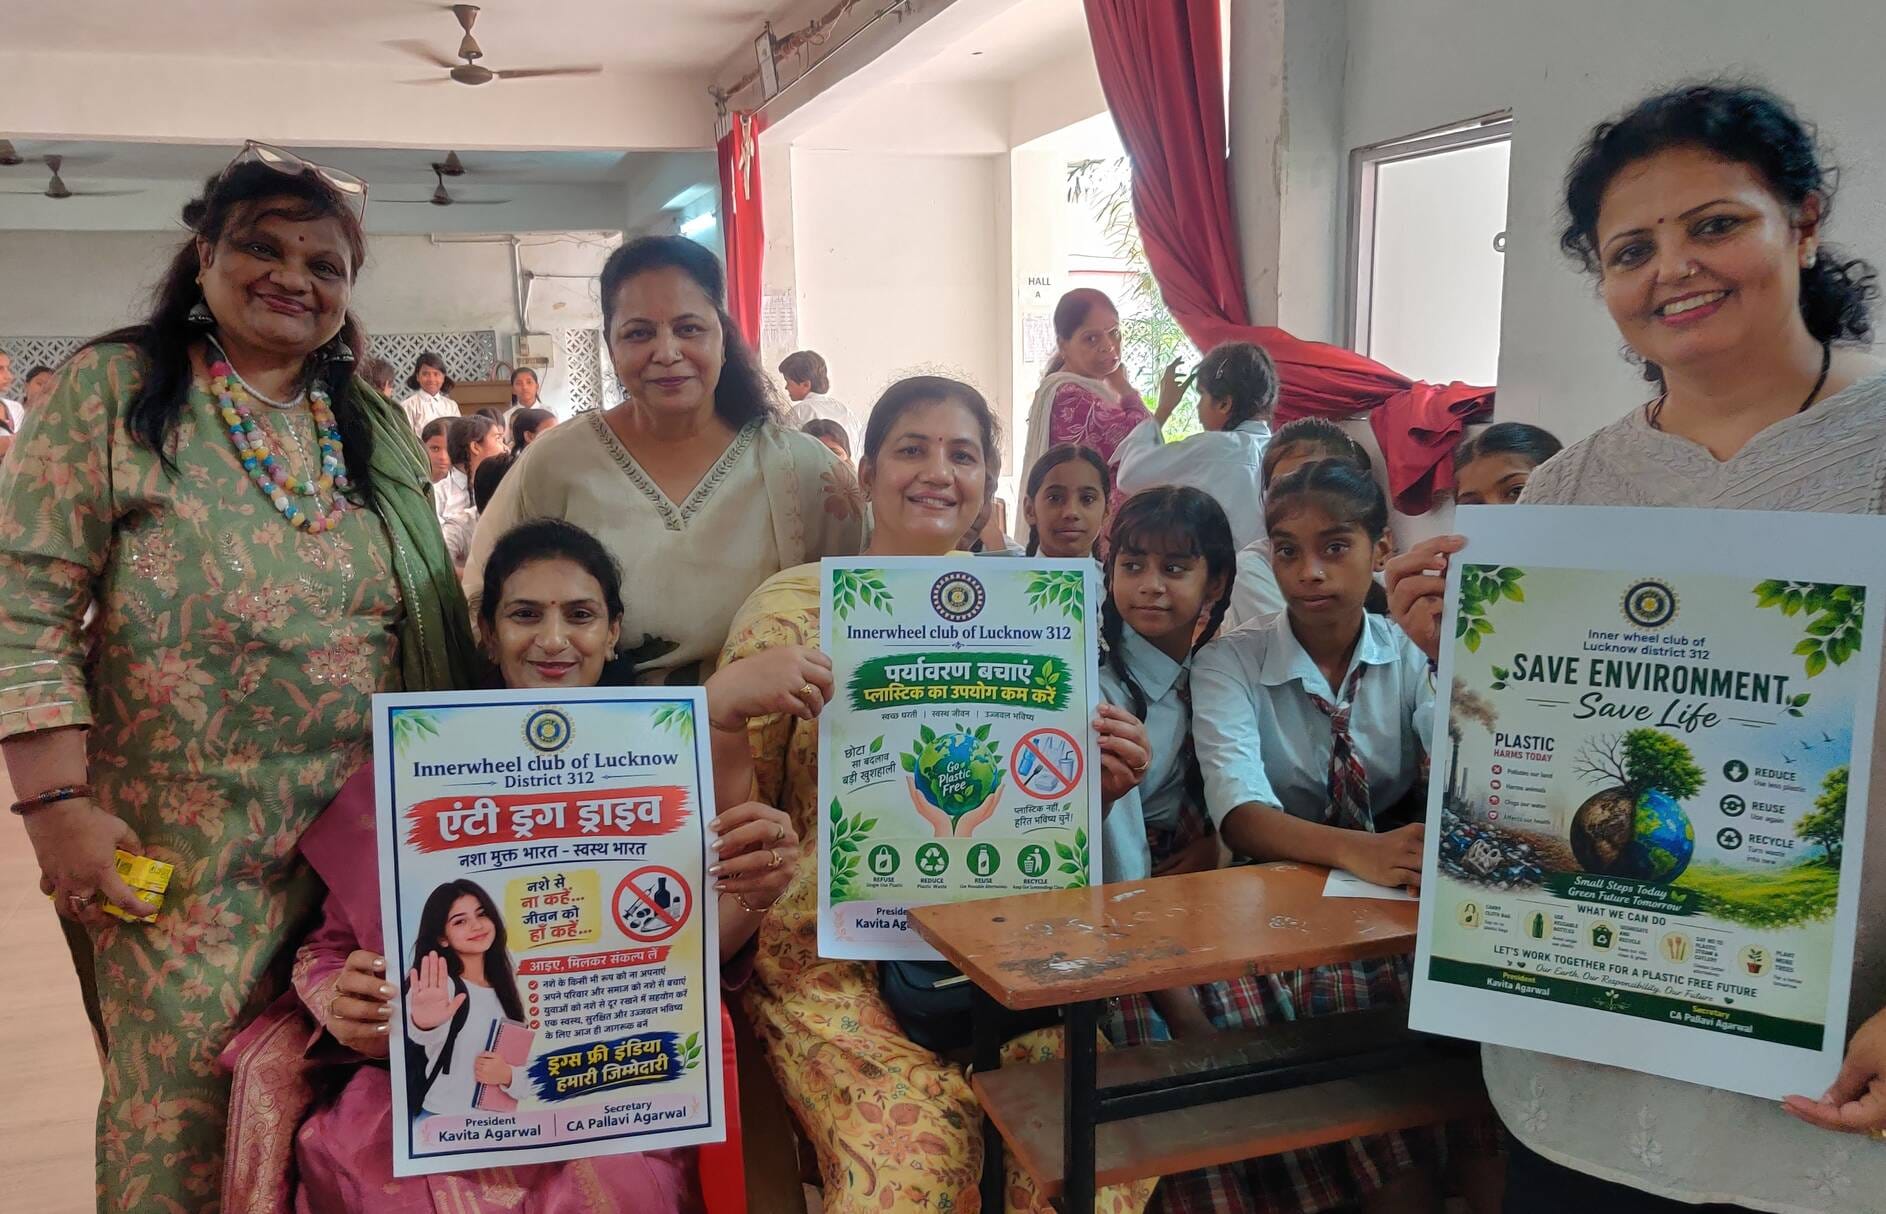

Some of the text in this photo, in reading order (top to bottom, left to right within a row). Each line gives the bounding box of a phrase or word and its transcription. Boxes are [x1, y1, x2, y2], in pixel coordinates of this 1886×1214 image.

[1028, 277, 1051, 285] HALL
[848, 625, 1071, 639] Innerwheel club of Lucknow 312
[1588, 629, 1706, 647] Inner wheel club of
[1583, 641, 1710, 660] Lucknow district 312
[885, 656, 1034, 684] पर्यावरण बचाएं
[1512, 653, 1789, 705] SAVE ENVIRONMENT
[863, 681, 1056, 705] प्लास्टिक का उपयोग कम करें
[951, 709, 970, 717] जीवन
[1573, 692, 1721, 733] Save Life
[1495, 733, 1555, 751] PLASTIC
[844, 745, 866, 758] छोटा
[851, 752, 889, 768] सा बदलाव
[1494, 749, 1552, 762] HARMS TODAY
[414, 751, 679, 778] Innerwheel club of Lucknow
[860, 763, 896, 783] खुशहाली
[947, 762, 960, 772] Go
[505, 773, 595, 789] District 312
[938, 768, 971, 785] Plastic
[1755, 768, 1797, 781] REDUCE
[943, 781, 967, 796] Free
[1014, 803, 1044, 815] प्लास्टिक
[1752, 801, 1785, 814] REUSE
[437, 796, 664, 841] एंटी ड्रग ड्राइव
[1015, 816, 1031, 828] हरित
[1034, 814, 1056, 825] भविष्य
[1749, 834, 1795, 849] RECYCLE
[459, 842, 648, 868] नशा मुक्त भारत स्वस्थ भारत
[527, 874, 565, 892] नशे से
[1574, 876, 1668, 898] Small Steps Today
[520, 896, 539, 909] ना
[1568, 887, 1682, 912] Green Future Tomorrow
[522, 906, 579, 925] जीवन को
[1577, 904, 1666, 925] WHAT WE CAN DO
[529, 923, 545, 942] हाँ
[856, 919, 890, 929] Kavita
[568, 955, 607, 968] मिलकर
[611, 951, 645, 964] संकल्प
[558, 978, 566, 987] के
[568, 976, 587, 986] किसी
[589, 974, 598, 984] भी
[616, 971, 626, 980] को
[1493, 945, 1519, 956] LET'S
[1522, 949, 1551, 961] WORK
[1555, 955, 1605, 971] TOGETHER
[1610, 964, 1629, 975] FOR
[1632, 968, 1638, 976] A
[1642, 970, 1684, 985] PLASTIC
[1688, 977, 1713, 989] FREE
[1716, 983, 1757, 997] FUTURE
[1536, 964, 1553, 973] Our
[1583, 972, 1599, 981] Our
[1664, 986, 1681, 996] Our
[543, 991, 561, 1001] अपने
[564, 989, 588, 1000] परिवार
[591, 986, 604, 996] और
[607, 985, 629, 994] समाज
[631, 982, 641, 991] को
[1515, 982, 1550, 996] Agarwal
[544, 1019, 558, 1027] एक
[614, 1010, 627, 1019] और
[660, 1003, 683, 1014] भविष्य
[571, 1002, 581, 1013] को
[1669, 1010, 1683, 1020] CA
[1715, 1018, 1753, 1033] Agarwal
[545, 1031, 553, 1039] के
[555, 1028, 572, 1039] लिए
[574, 1028, 592, 1036] आज
[594, 1025, 601, 1035] ही
[546, 1038, 662, 1075] ड्रग्स फ्री इंडिया
[556, 1055, 669, 1093] हमारी जिम्मेदारी
[604, 1100, 652, 1115] Secretary
[465, 1116, 516, 1127] President
[566, 1106, 686, 1132] CA Pallavi Agarwal
[439, 1125, 541, 1143] Kavita Agarwal
